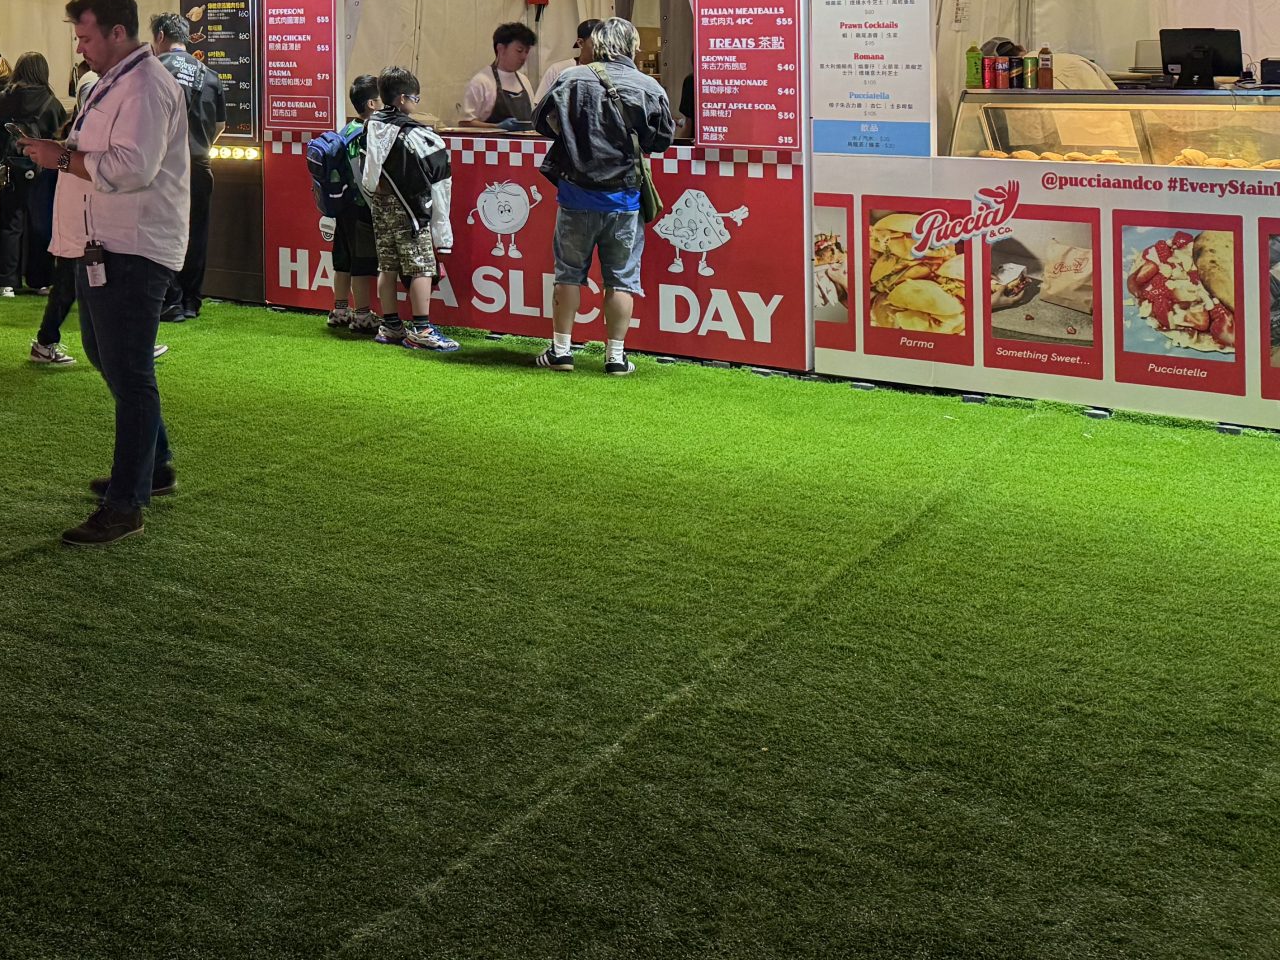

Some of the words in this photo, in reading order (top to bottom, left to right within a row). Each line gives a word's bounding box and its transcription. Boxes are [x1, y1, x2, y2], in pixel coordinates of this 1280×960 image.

[701, 7, 734, 15] ITALIAN
[735, 6, 785, 14] MEATBALLS
[736, 17, 753, 25] 4PC
[840, 21, 862, 29] Prawn
[864, 21, 899, 29] Cocktails
[708, 38, 756, 49] TREATS
[758, 36, 785, 49] 茶點
[853, 52, 885, 60] Romana
[777, 63, 795, 71] $40
[777, 87, 795, 95] $40
[314, 110, 327, 118] $20
[778, 136, 793, 144] $15
[1041, 171, 1163, 192] @pucciaandco
[912, 200, 1004, 254] Puccia
[989, 230, 997, 238] &
[998, 226, 1013, 236] Co.
[659, 283, 784, 343] DAY
[900, 336, 935, 349] Parma
[995, 347, 1048, 362] Something
[1050, 352, 1090, 366] Sweet...
[1147, 363, 1208, 378] Pucciatella
